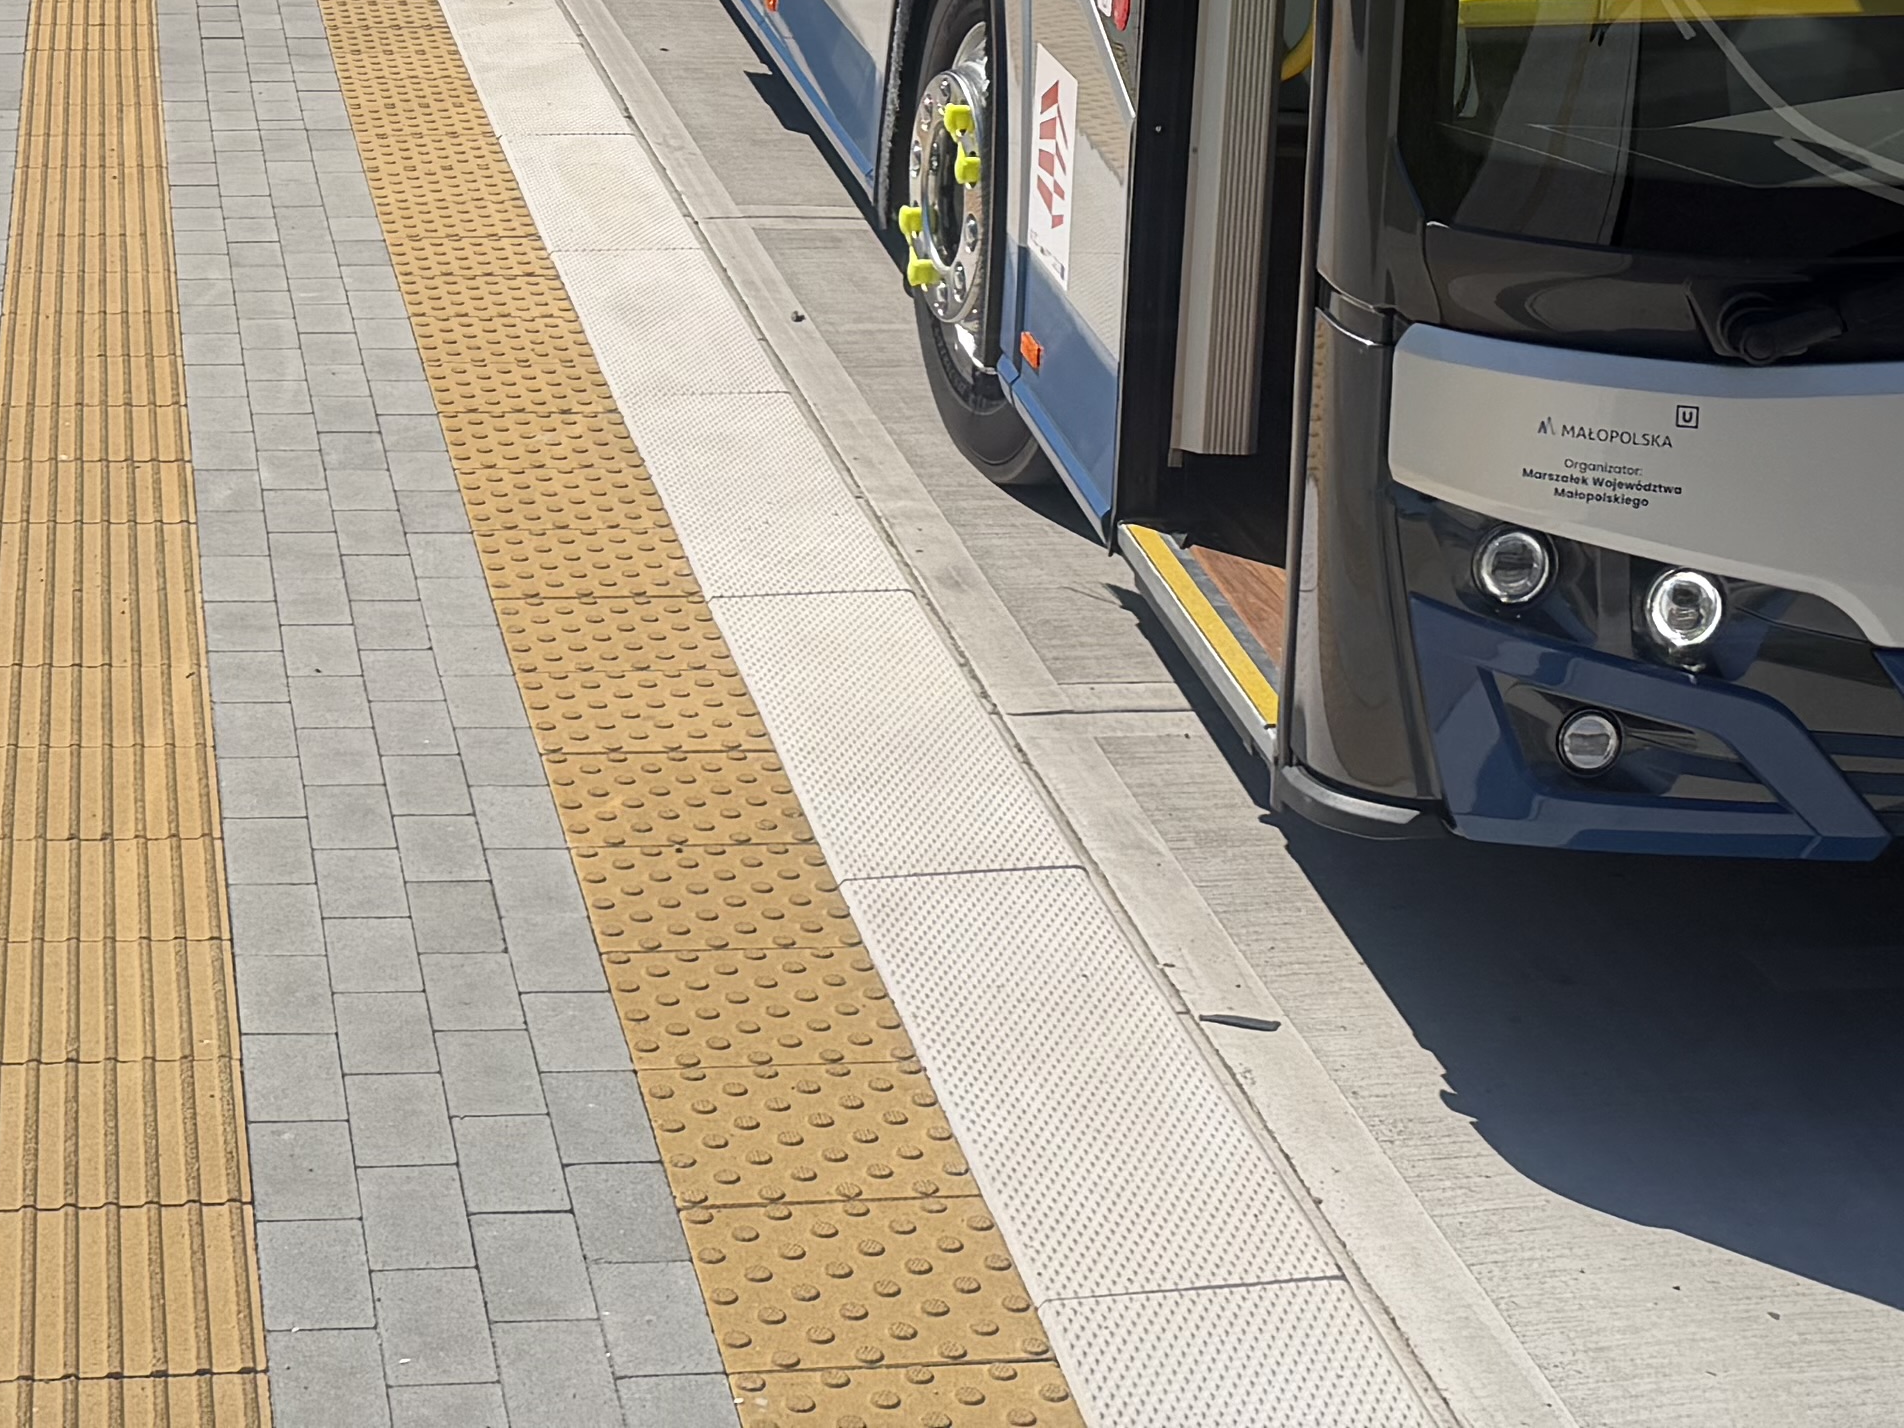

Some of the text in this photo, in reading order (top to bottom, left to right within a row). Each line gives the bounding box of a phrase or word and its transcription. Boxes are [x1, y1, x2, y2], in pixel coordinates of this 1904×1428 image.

[1561, 424, 1673, 448] MAŁOPOLSKA
[1522, 467, 1683, 495] Marszałek Województwa
[1553, 487, 1649, 509] Małopolskiego
